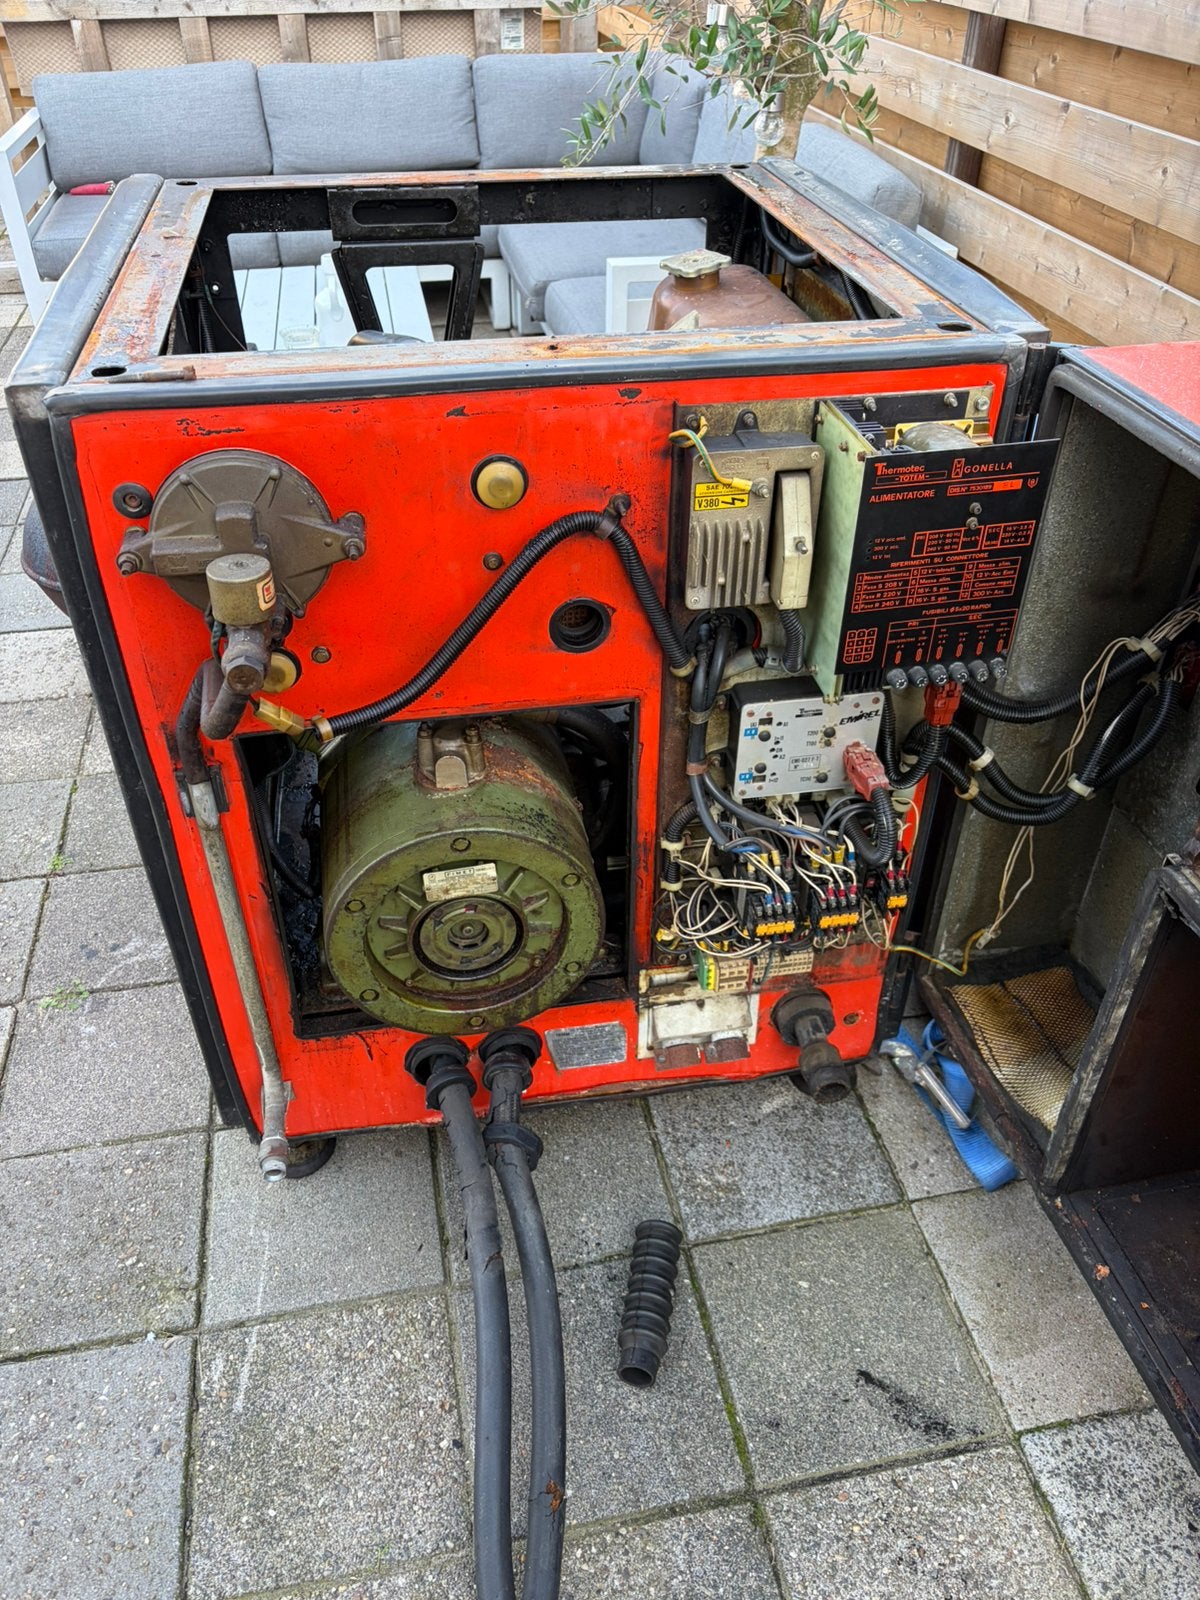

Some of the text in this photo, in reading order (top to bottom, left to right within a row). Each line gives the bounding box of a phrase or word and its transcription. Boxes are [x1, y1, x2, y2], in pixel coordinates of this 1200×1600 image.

[875, 462, 925, 476] Thermotec
[964, 462, 1013, 474] GONELLA
[869, 489, 935, 503] ALIMENTATORE
[697, 498, 720, 509] V380
[890, 558, 930, 568] RIFERIMENTI
[946, 552, 989, 562] CONNETTORE
